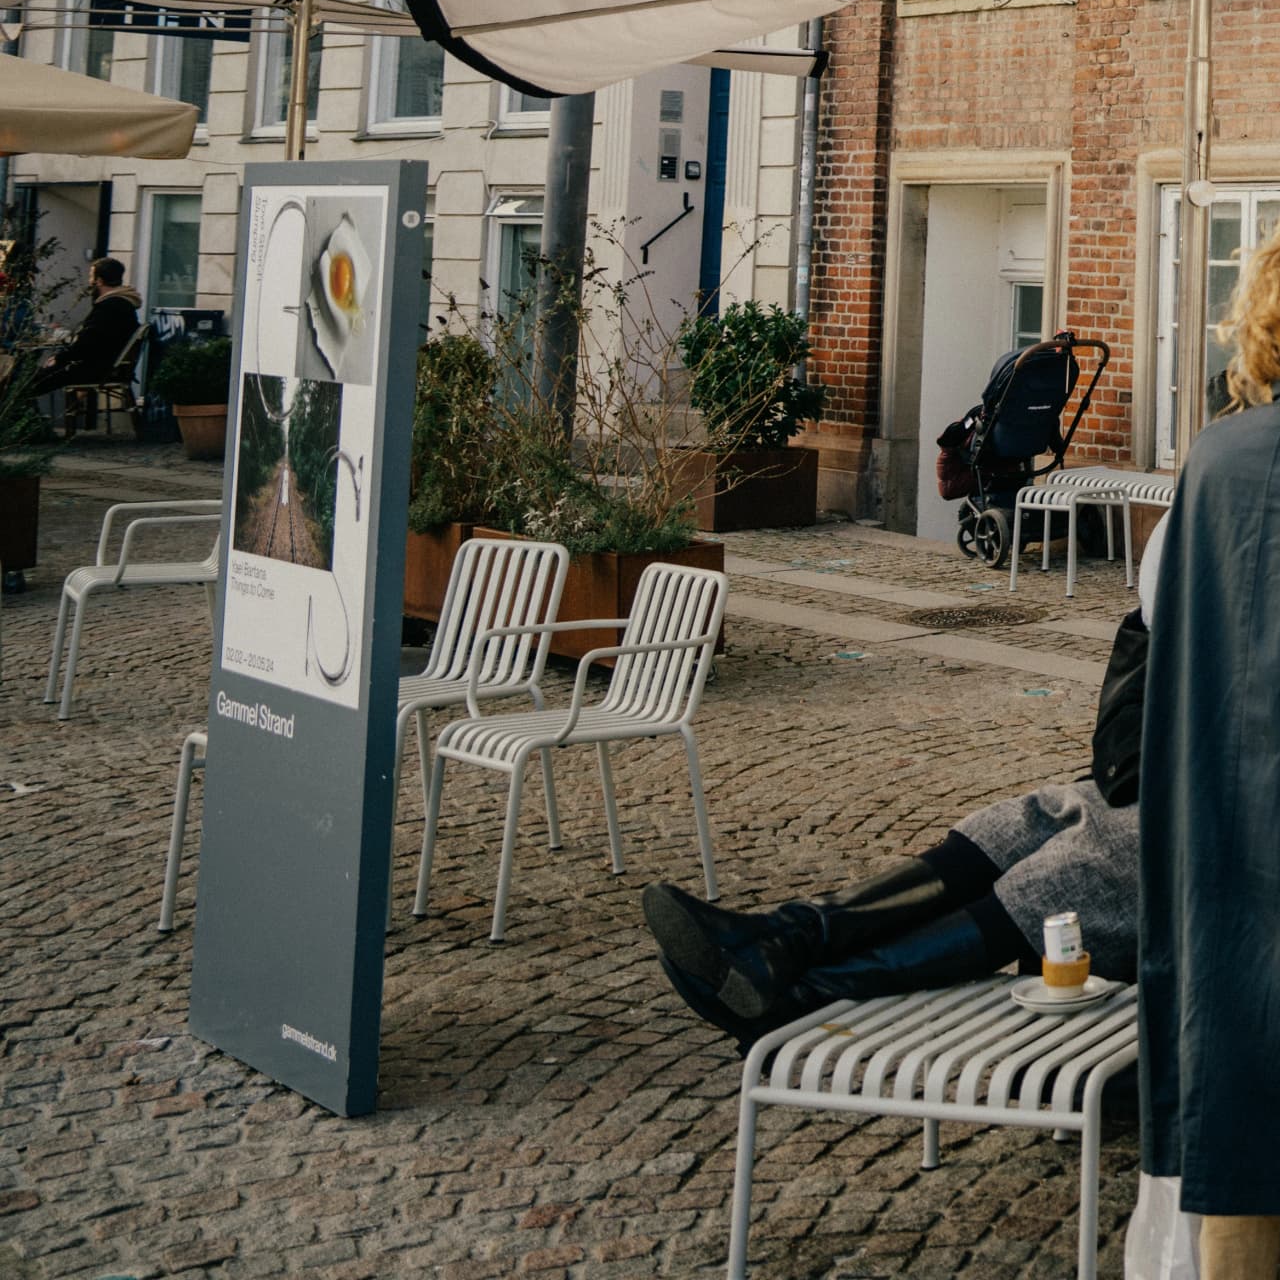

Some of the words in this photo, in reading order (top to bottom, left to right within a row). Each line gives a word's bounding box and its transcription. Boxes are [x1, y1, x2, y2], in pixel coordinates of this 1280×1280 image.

[216, 690, 259, 727] Gammel
[259, 704, 295, 739] Strand
[281, 1023, 337, 1063] gammelstrand.dk
